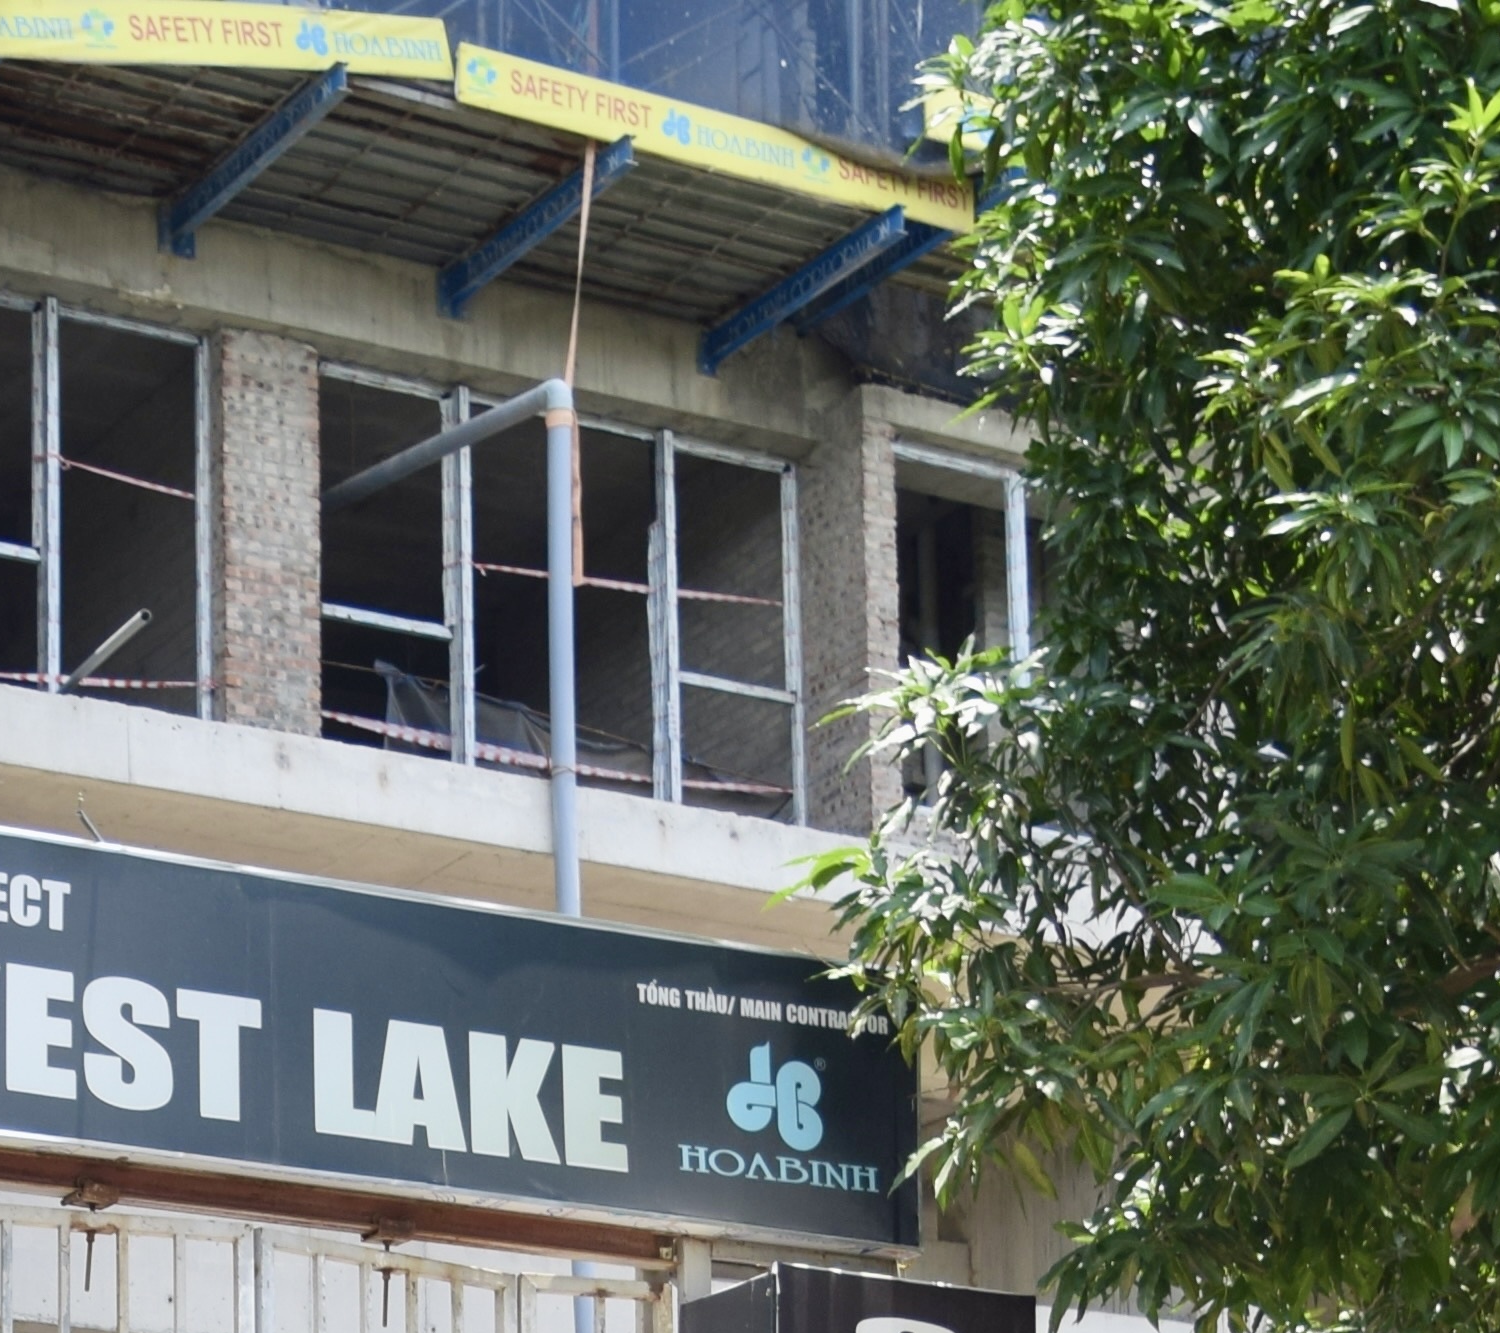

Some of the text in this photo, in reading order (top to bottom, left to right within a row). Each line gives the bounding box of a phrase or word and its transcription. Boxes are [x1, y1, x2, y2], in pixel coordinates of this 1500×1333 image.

[129, 14, 284, 48] SAFETY FIRST
[510, 69, 652, 129] SAFETY FIRST
[838, 155, 974, 213] SAFETY FIRST
[636, 979, 681, 1009] TỔNG
[740, 997, 782, 1022] MAIN
[786, 1003, 889, 1036] CONTRATOR
[312, 1009, 630, 1174] LAKE
[677, 1143, 880, 1193] HOABINH
